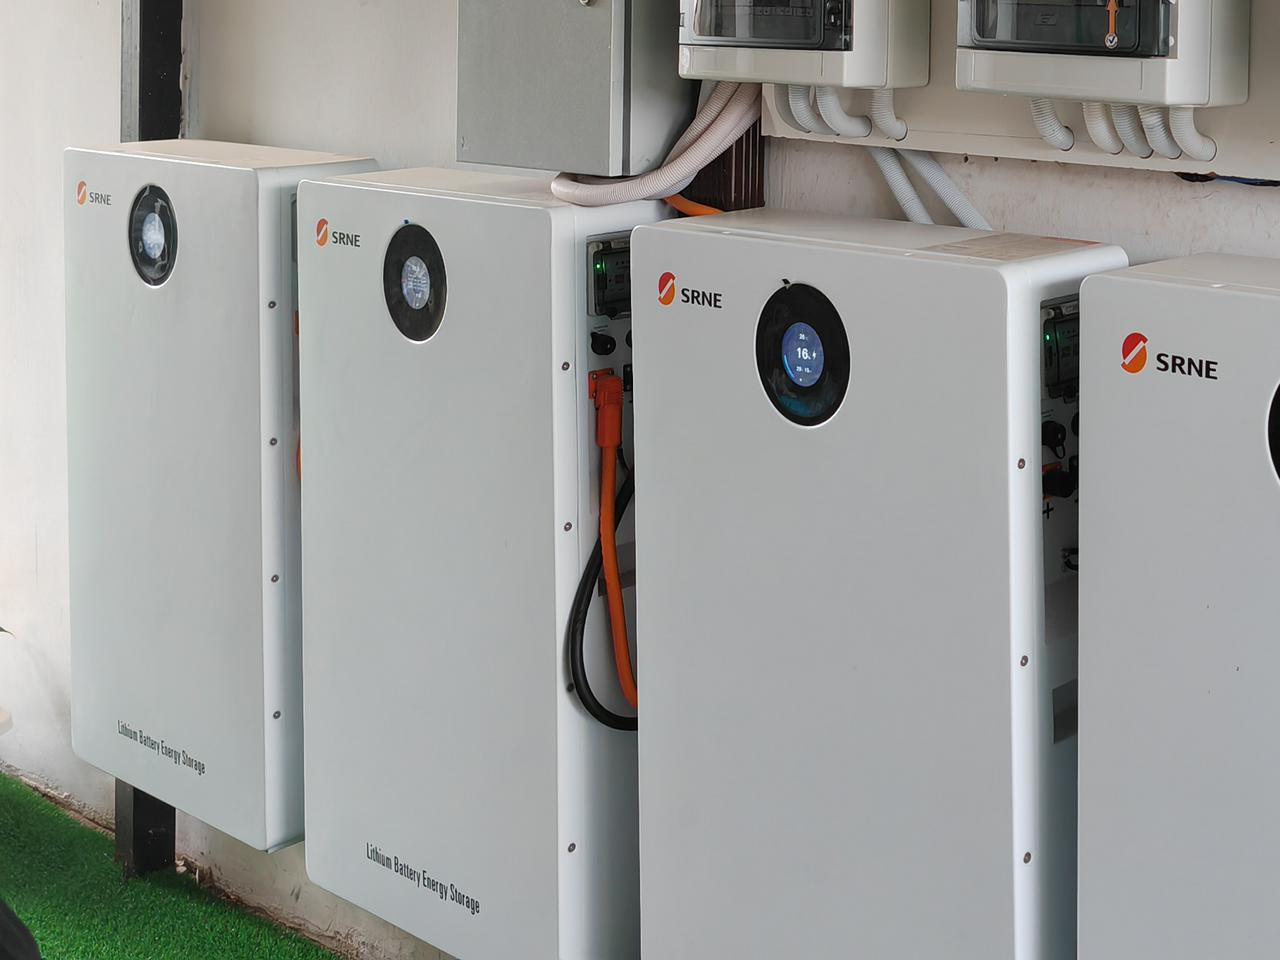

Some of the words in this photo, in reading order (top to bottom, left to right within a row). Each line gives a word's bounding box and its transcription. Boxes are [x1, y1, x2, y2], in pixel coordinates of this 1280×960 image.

[89, 191, 112, 206] SRNE
[331, 231, 360, 248] SRNE
[681, 288, 722, 309] SRNE
[1156, 352, 1218, 380] SRNE
[117, 719, 138, 742] Lithium
[138, 729, 160, 756] Battery
[160, 740, 181, 766] Energy
[181, 749, 206, 776] Storage
[366, 841, 393, 870] Lithium
[393, 855, 421, 888] Battery
[422, 869, 449, 901] Energy
[449, 883, 480, 916] Storage
